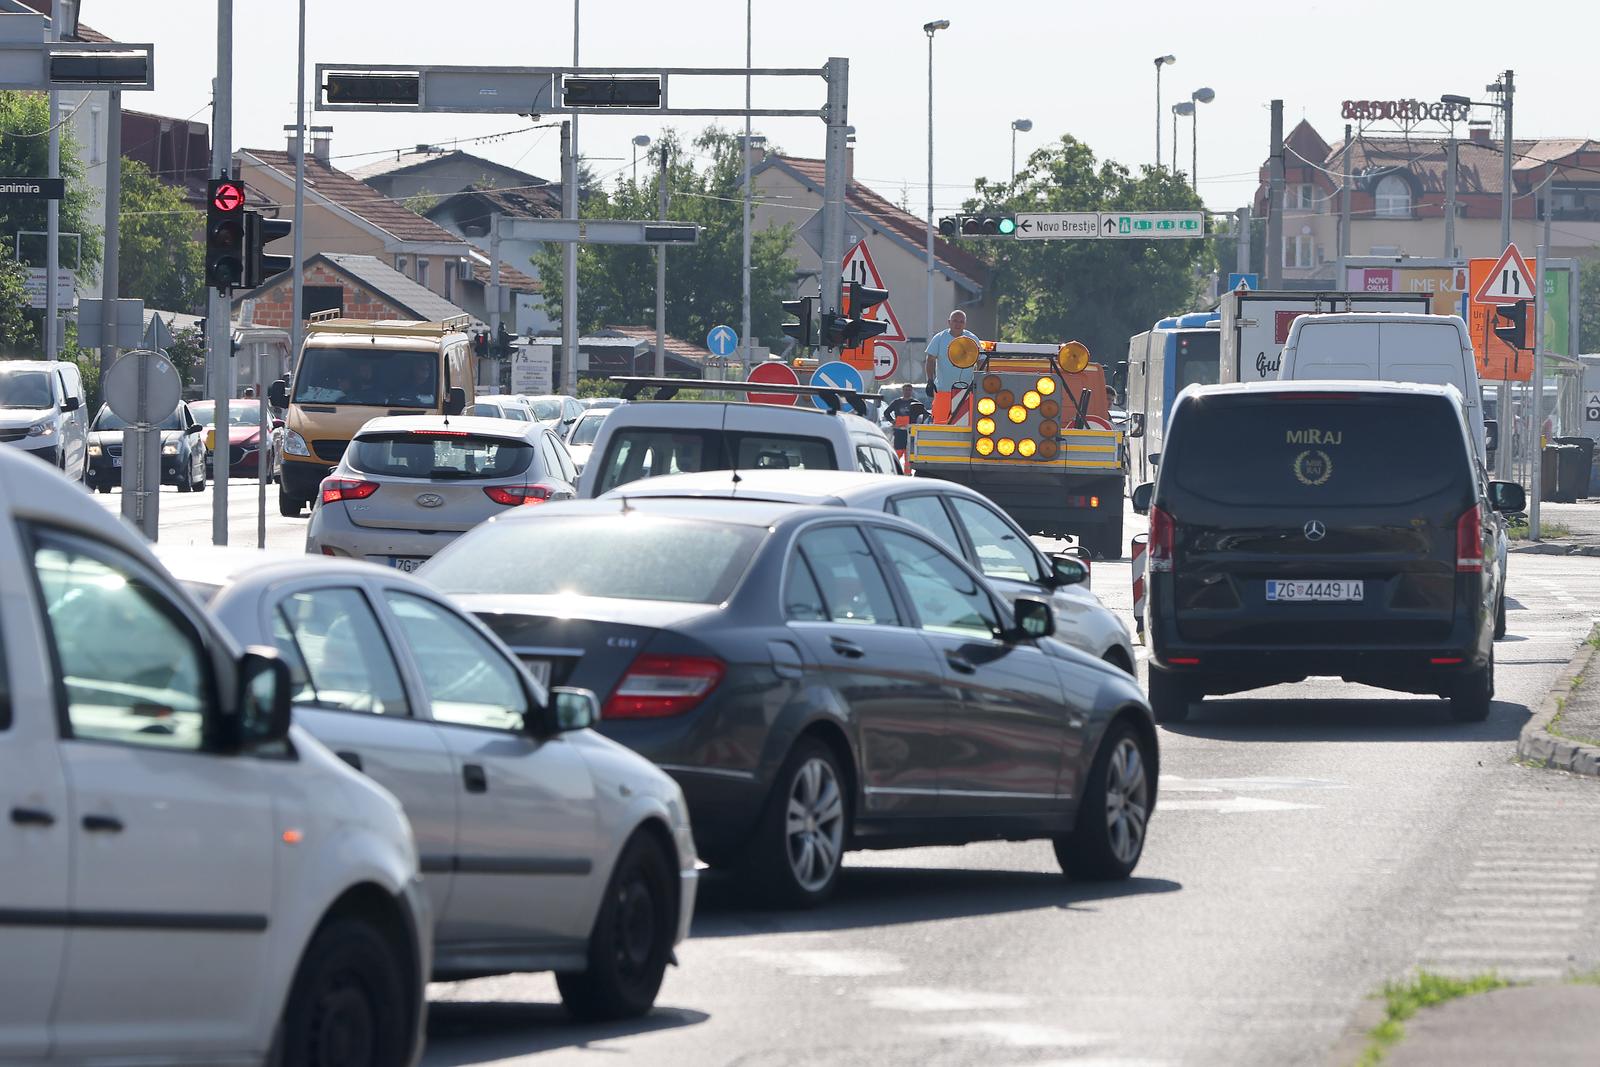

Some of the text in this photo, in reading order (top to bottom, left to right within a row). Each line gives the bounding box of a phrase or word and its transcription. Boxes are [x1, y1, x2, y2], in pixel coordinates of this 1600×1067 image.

[1037, 220, 1096, 234] Novo Brestje
[1410, 279, 1436, 292] IME
[1286, 429, 1342, 445] MIRAJ
[1278, 583, 1295, 597] ZG
